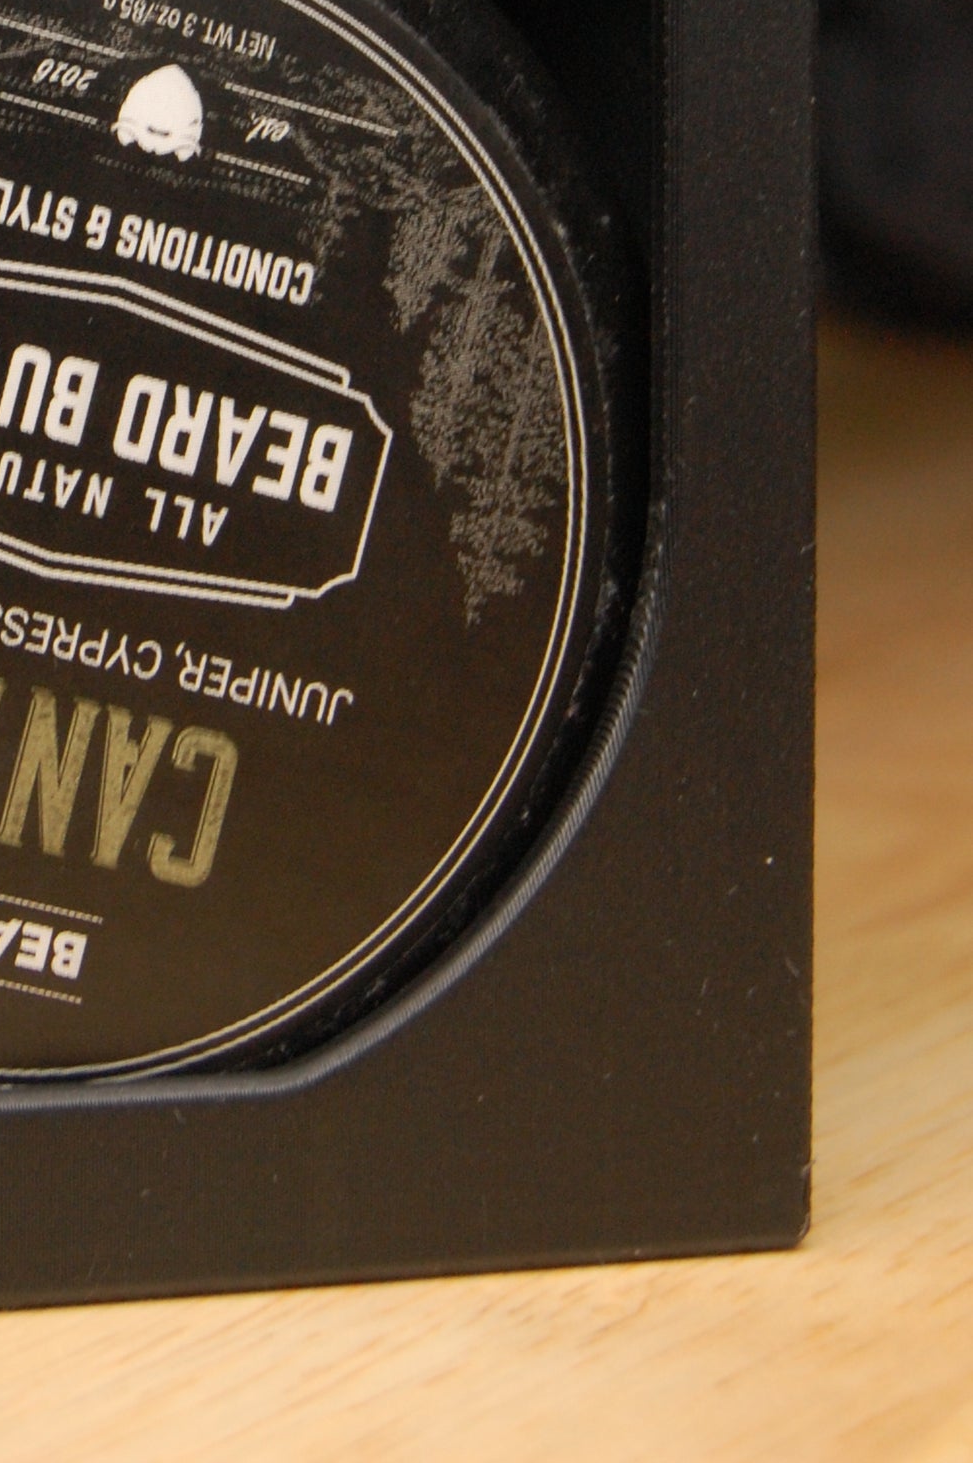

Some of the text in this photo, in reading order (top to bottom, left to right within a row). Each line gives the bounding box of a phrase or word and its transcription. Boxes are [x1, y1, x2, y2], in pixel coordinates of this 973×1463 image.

[181, 12, 198, 38] 3
[201, 16, 234, 51] WT.
[234, 29, 277, 61] NET
[31, 57, 99, 93] 2016
[245, 111, 291, 143] est.
[85, 204, 113, 251] &
[115, 213, 315, 306] CONDITIONS
[113, 374, 354, 513] BEARD
[144, 487, 229, 548] ALL
[174, 640, 355, 726] JUNIPER,
